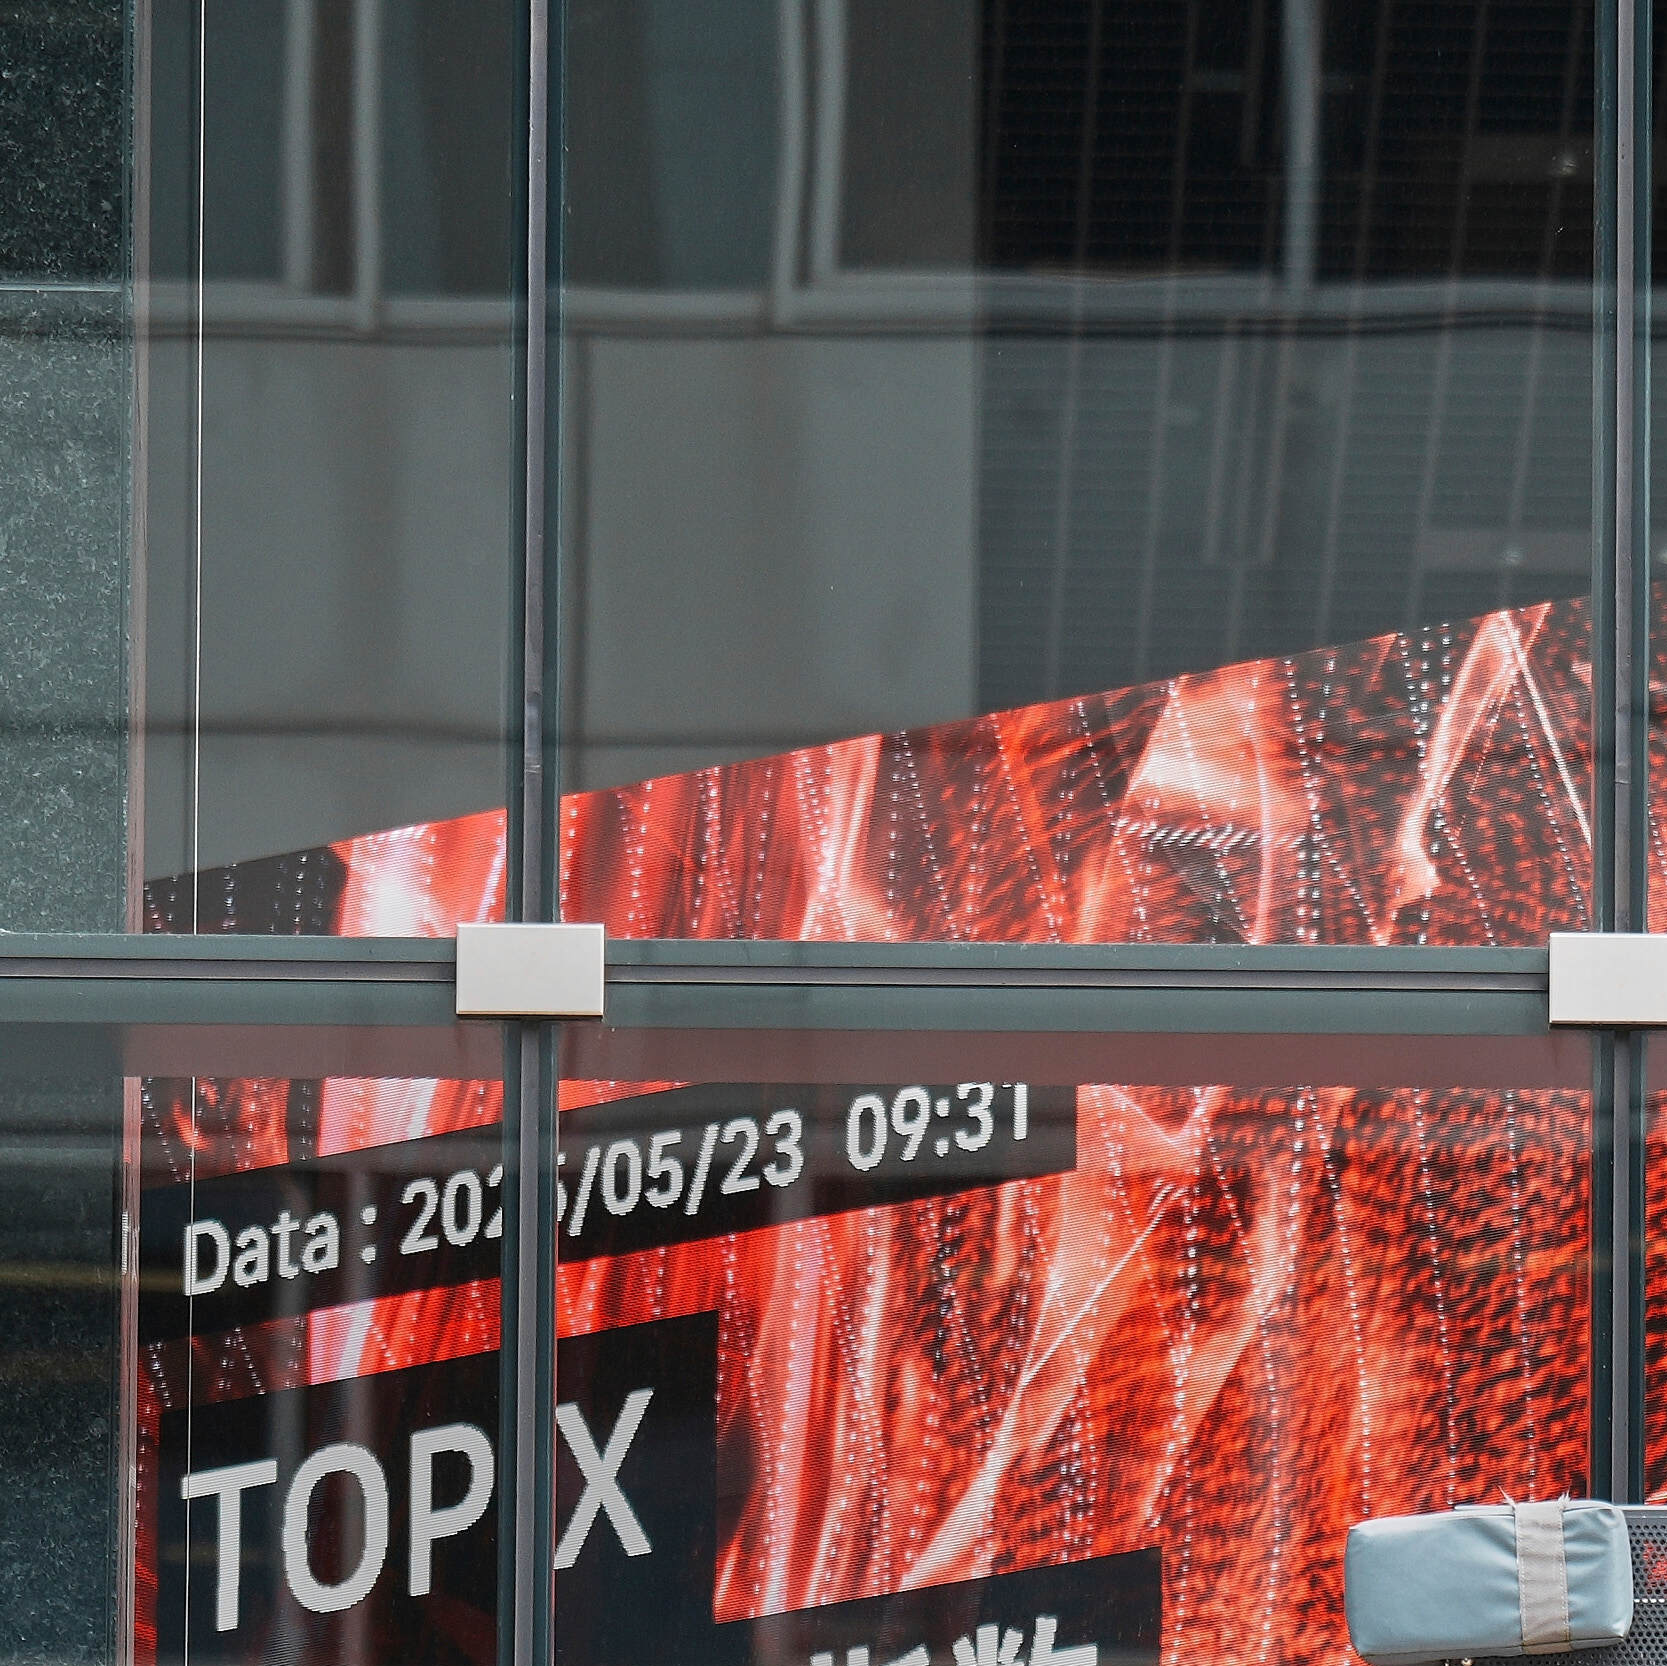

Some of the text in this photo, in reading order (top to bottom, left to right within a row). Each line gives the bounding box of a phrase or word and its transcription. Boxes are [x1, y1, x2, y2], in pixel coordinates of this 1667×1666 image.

[183, 1208, 340, 1296] Data
[399, 1108, 802, 1255] 20/05/23
[845, 1081, 1029, 1172] 09:31
[181, 1387, 653, 1631] TOPX
